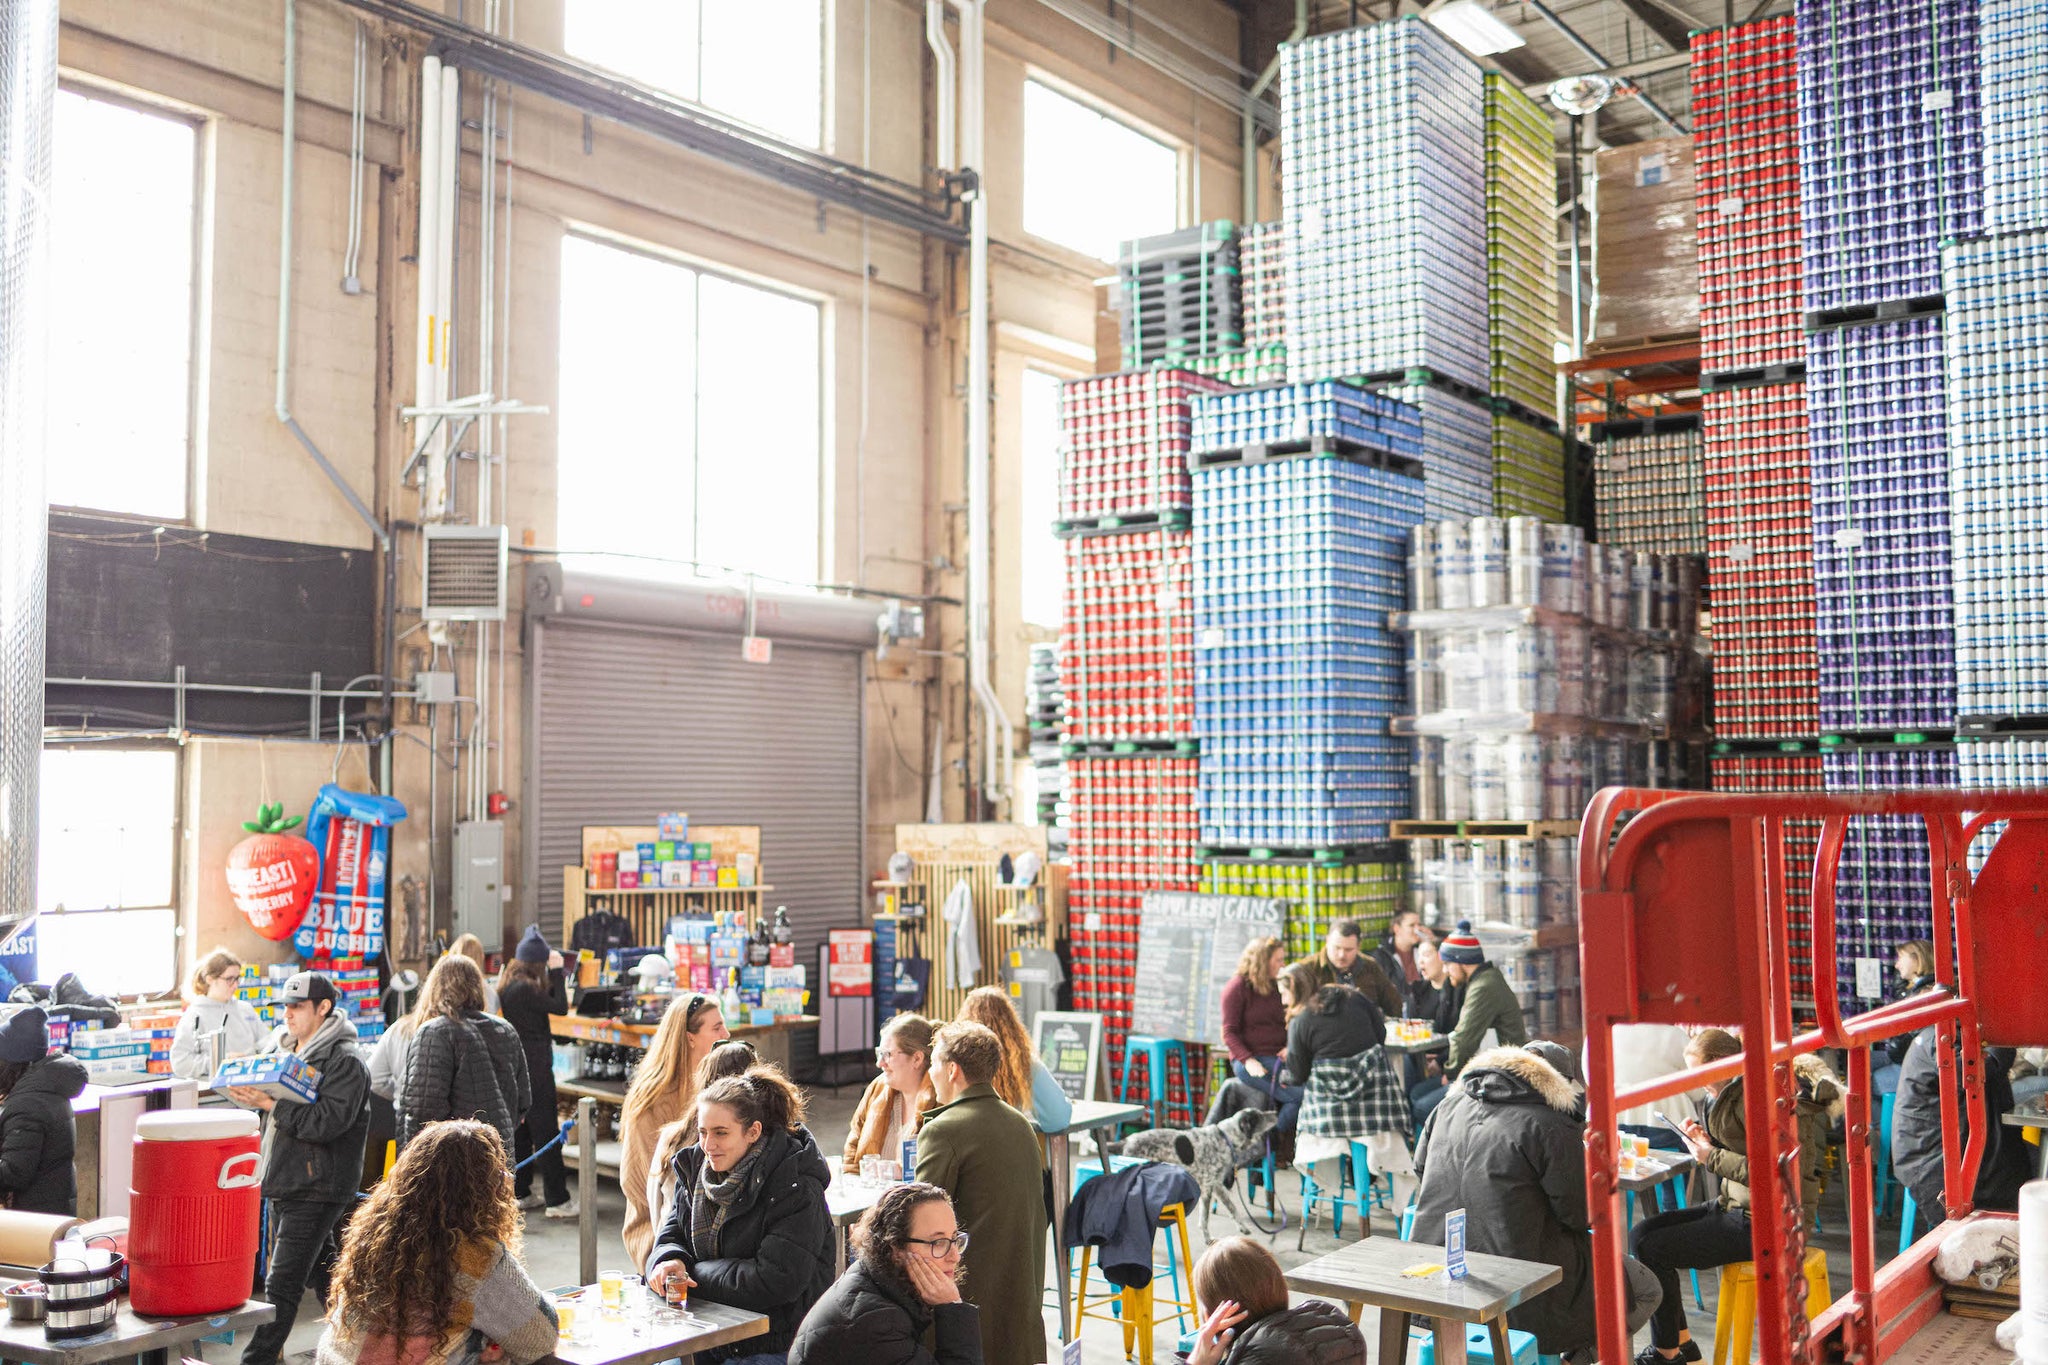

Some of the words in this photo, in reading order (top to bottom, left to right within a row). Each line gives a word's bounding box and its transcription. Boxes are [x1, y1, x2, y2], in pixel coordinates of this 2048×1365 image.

[302, 902, 384, 933] BLUE
[1224, 896, 1279, 923] CANS
[297, 929, 383, 953] SLUSHIE
